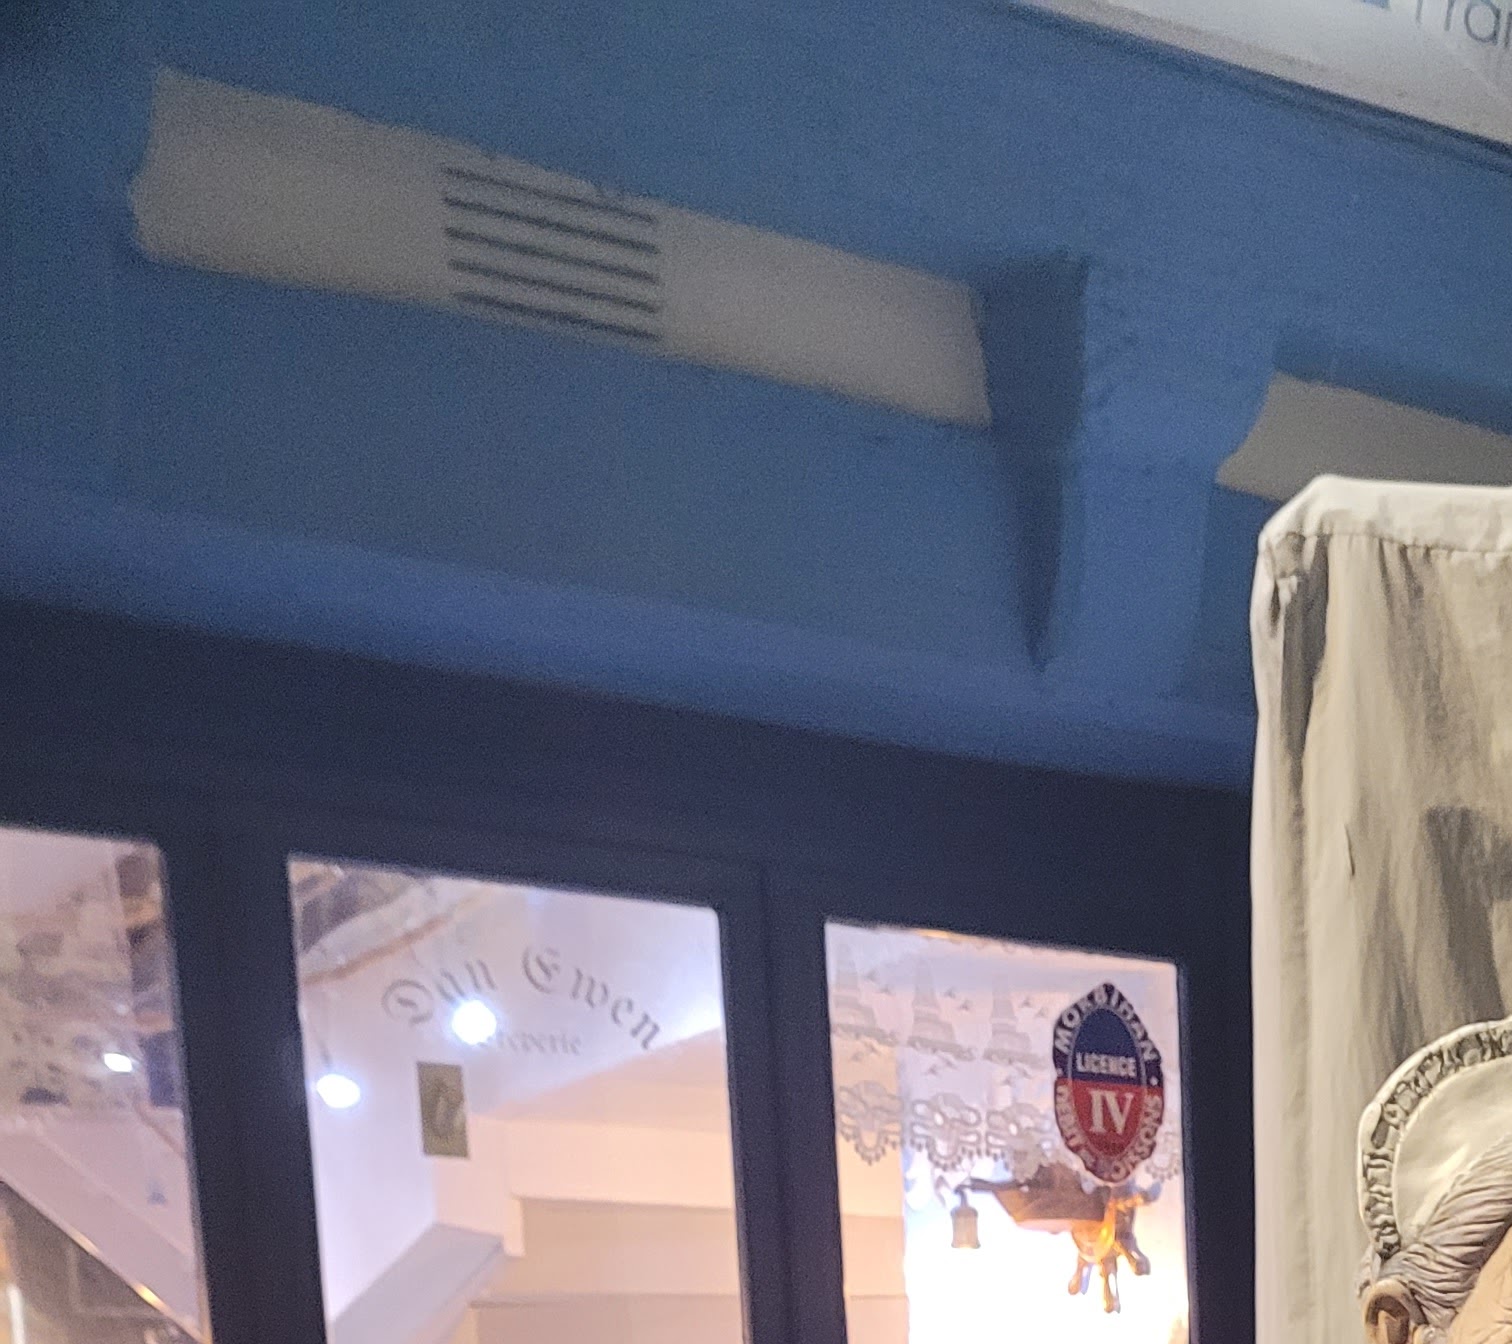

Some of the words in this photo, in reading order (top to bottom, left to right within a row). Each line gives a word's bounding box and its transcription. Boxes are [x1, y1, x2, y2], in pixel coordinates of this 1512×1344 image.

[1054, 985, 1161, 1060] MORBIHAN
[1075, 1051, 1138, 1078] LICENCE
[1088, 1089, 1136, 1135] IV
